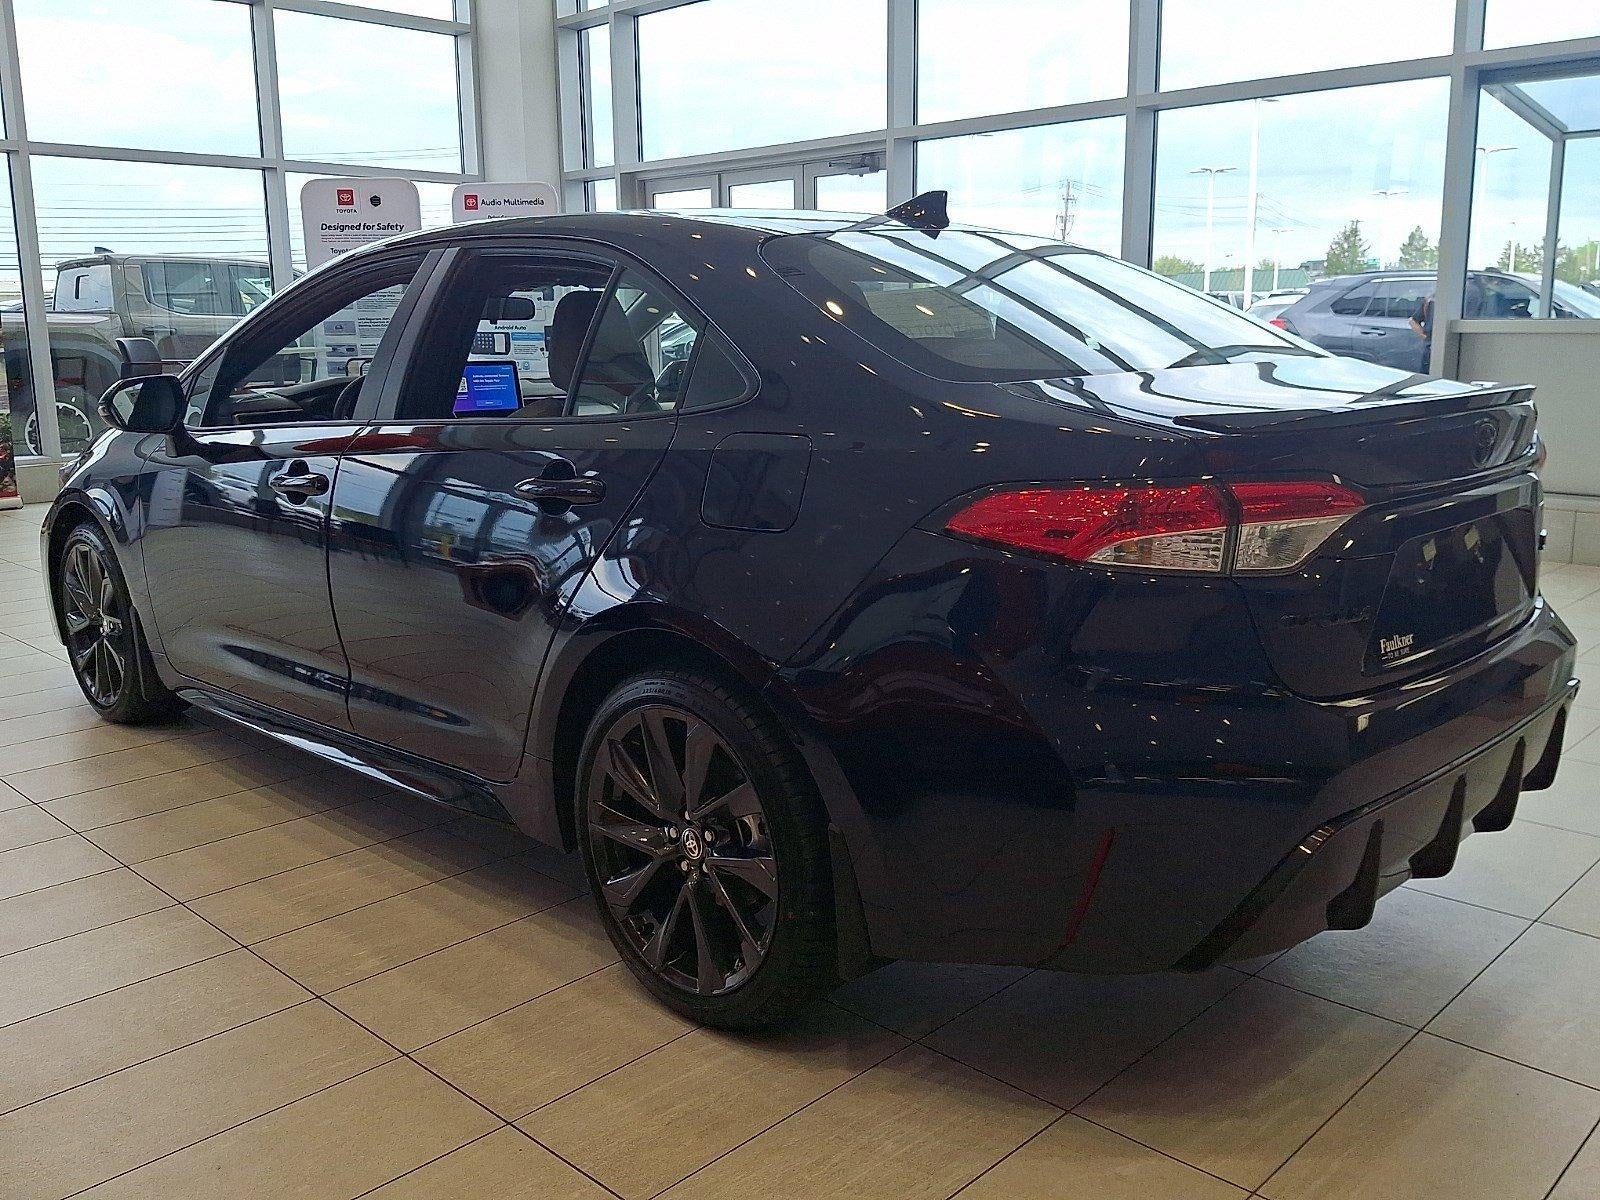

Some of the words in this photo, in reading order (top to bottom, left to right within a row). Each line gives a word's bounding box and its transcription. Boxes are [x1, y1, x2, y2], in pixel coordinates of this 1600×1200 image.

[481, 198, 502, 206] Audio
[503, 197, 545, 206] Multimedia
[320, 222, 361, 232] Designed
[362, 222, 376, 231] for
[376, 222, 405, 232] Safety
[1379, 633, 1414, 654] Faulkner
